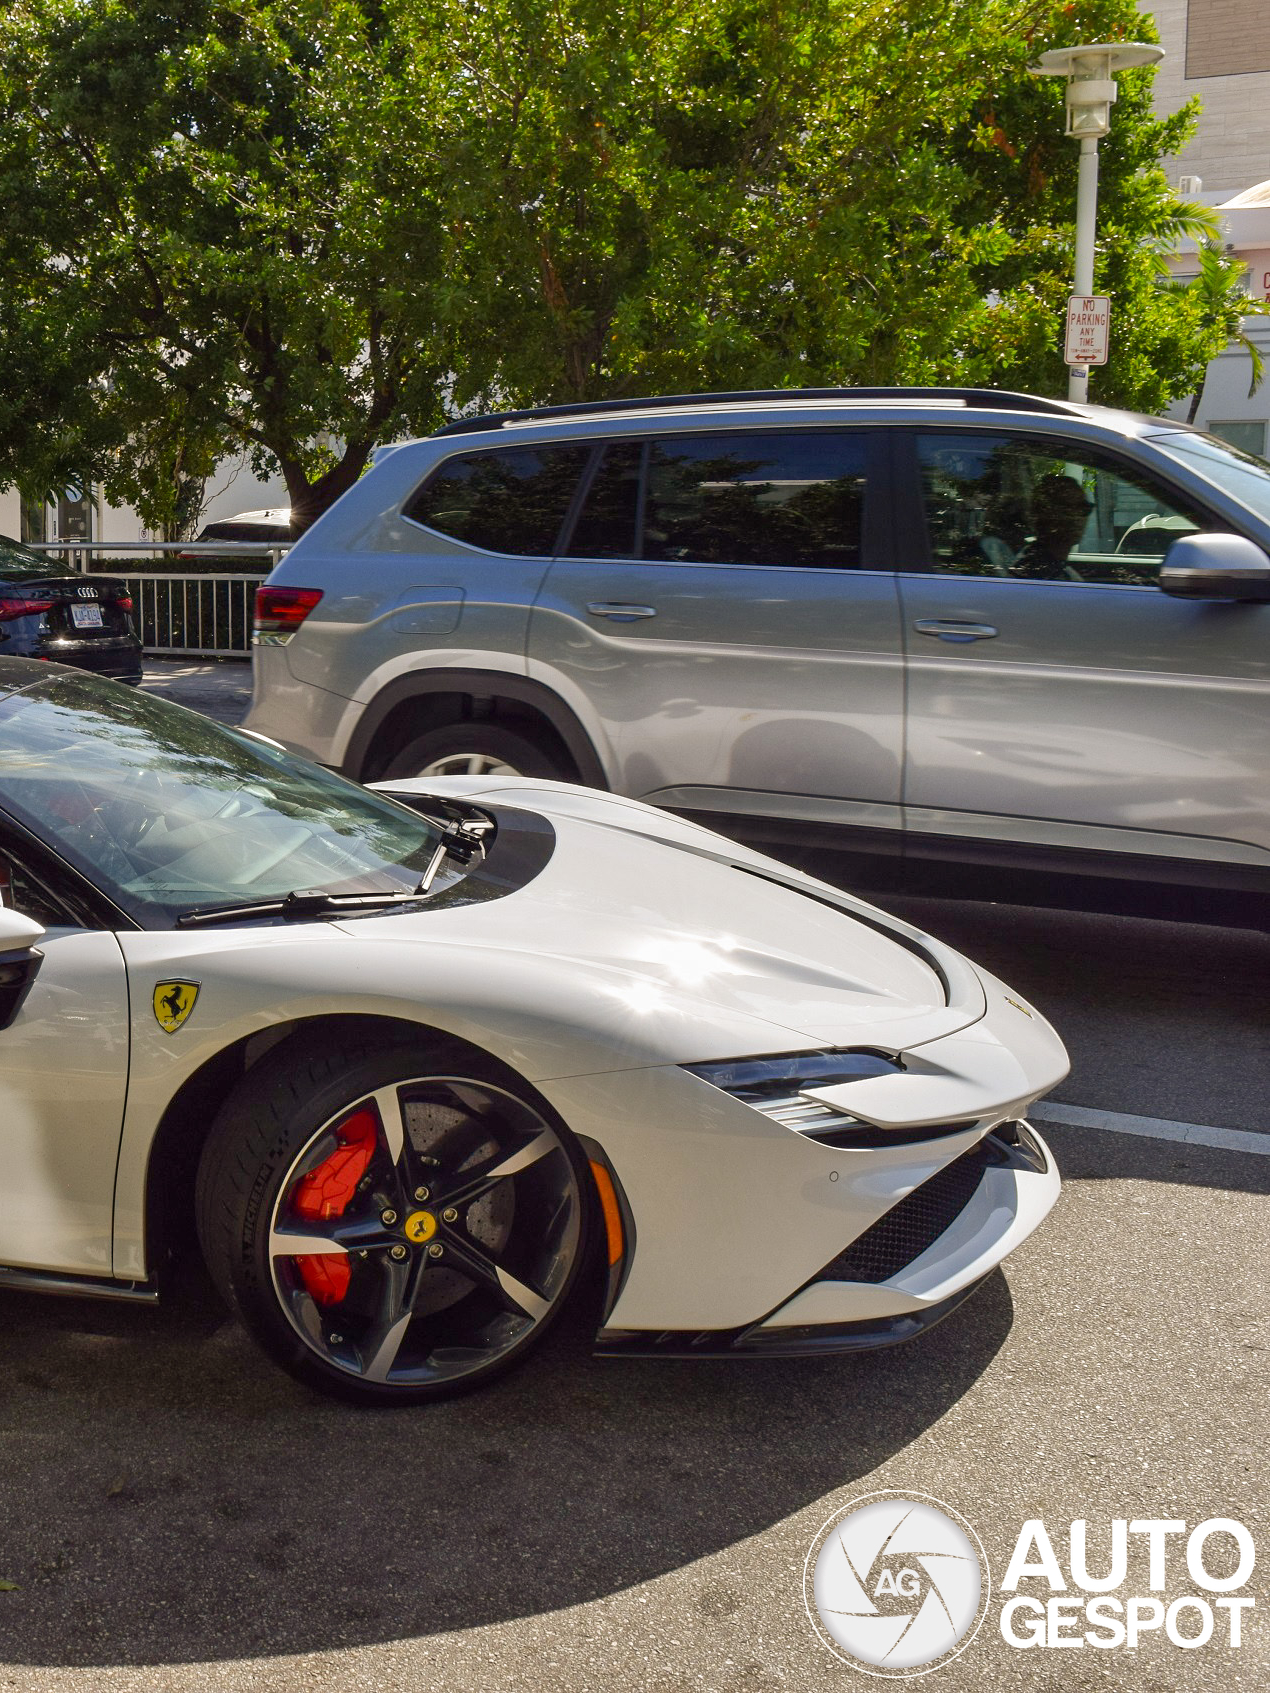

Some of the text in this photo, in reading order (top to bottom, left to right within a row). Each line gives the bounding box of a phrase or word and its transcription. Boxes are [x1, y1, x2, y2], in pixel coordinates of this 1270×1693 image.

[1082, 300, 1095, 311] NO
[1070, 313, 1106, 325] PARKING
[1079, 338, 1095, 346] TIME
